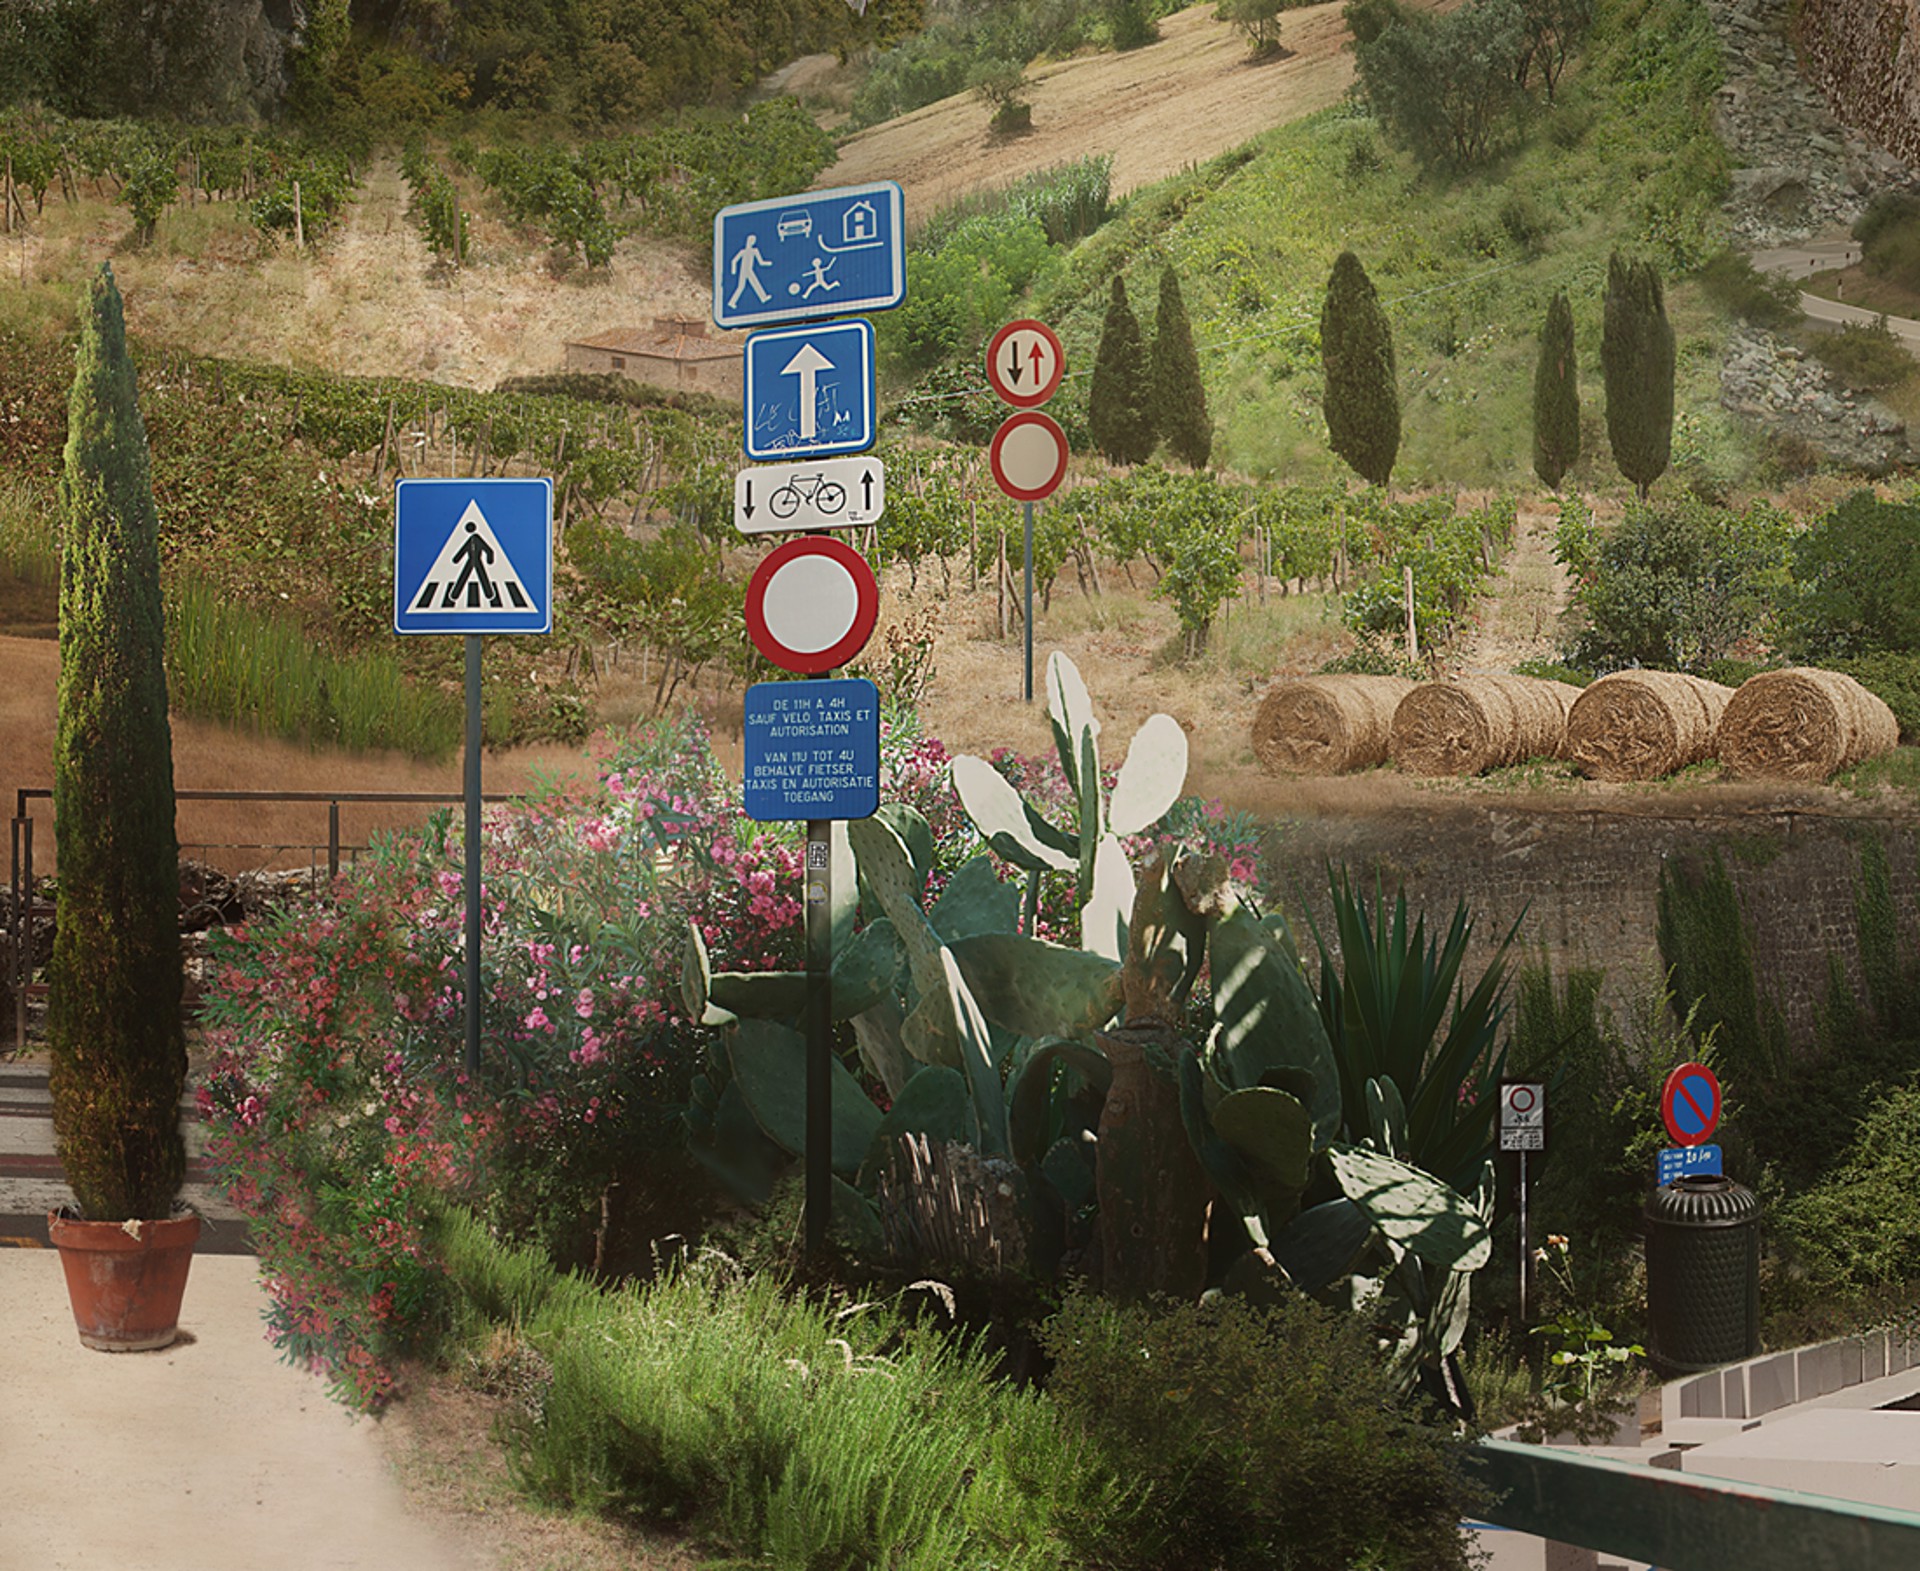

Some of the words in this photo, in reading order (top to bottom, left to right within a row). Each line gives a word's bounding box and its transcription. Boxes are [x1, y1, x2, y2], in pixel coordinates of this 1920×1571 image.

[773, 699, 789, 711] DE
[793, 699, 811, 709] 11H
[816, 698, 825, 709] A
[829, 697, 846, 708] 4H
[748, 713, 776, 725] SAUF
[819, 710, 852, 722] TAXIS
[856, 709, 871, 721] ET
[769, 723, 849, 737] AUTORISATION
[764, 752, 788, 763] VAN
[813, 750, 833, 761] TOT
[839, 749, 855, 760] 4U
[753, 764, 804, 777] BEHALVE
[746, 779, 777, 790] TAXIS
[782, 778, 797, 789] EN
[802, 776, 873, 789] AUTORISATIE
[783, 790, 834, 803] TOEGANG
